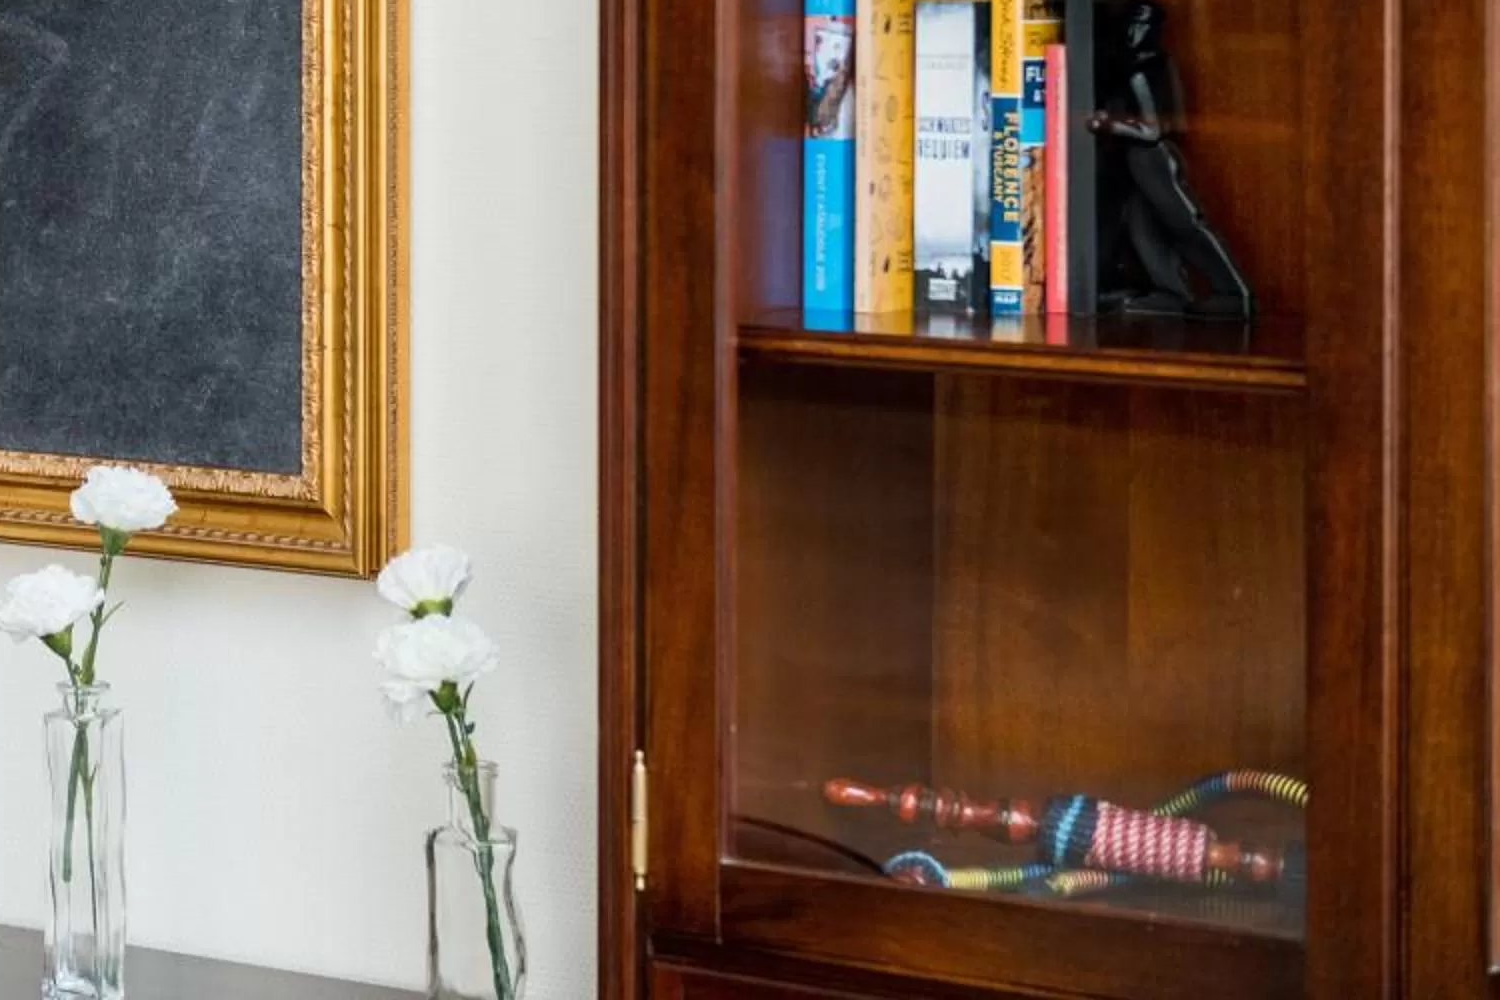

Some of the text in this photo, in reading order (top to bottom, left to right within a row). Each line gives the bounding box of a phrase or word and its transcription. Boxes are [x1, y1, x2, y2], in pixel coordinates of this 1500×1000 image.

[916, 139, 971, 160] REQUIEM
[993, 145, 1005, 204] TUSCANY
[1003, 111, 1020, 222] FLORENCE
